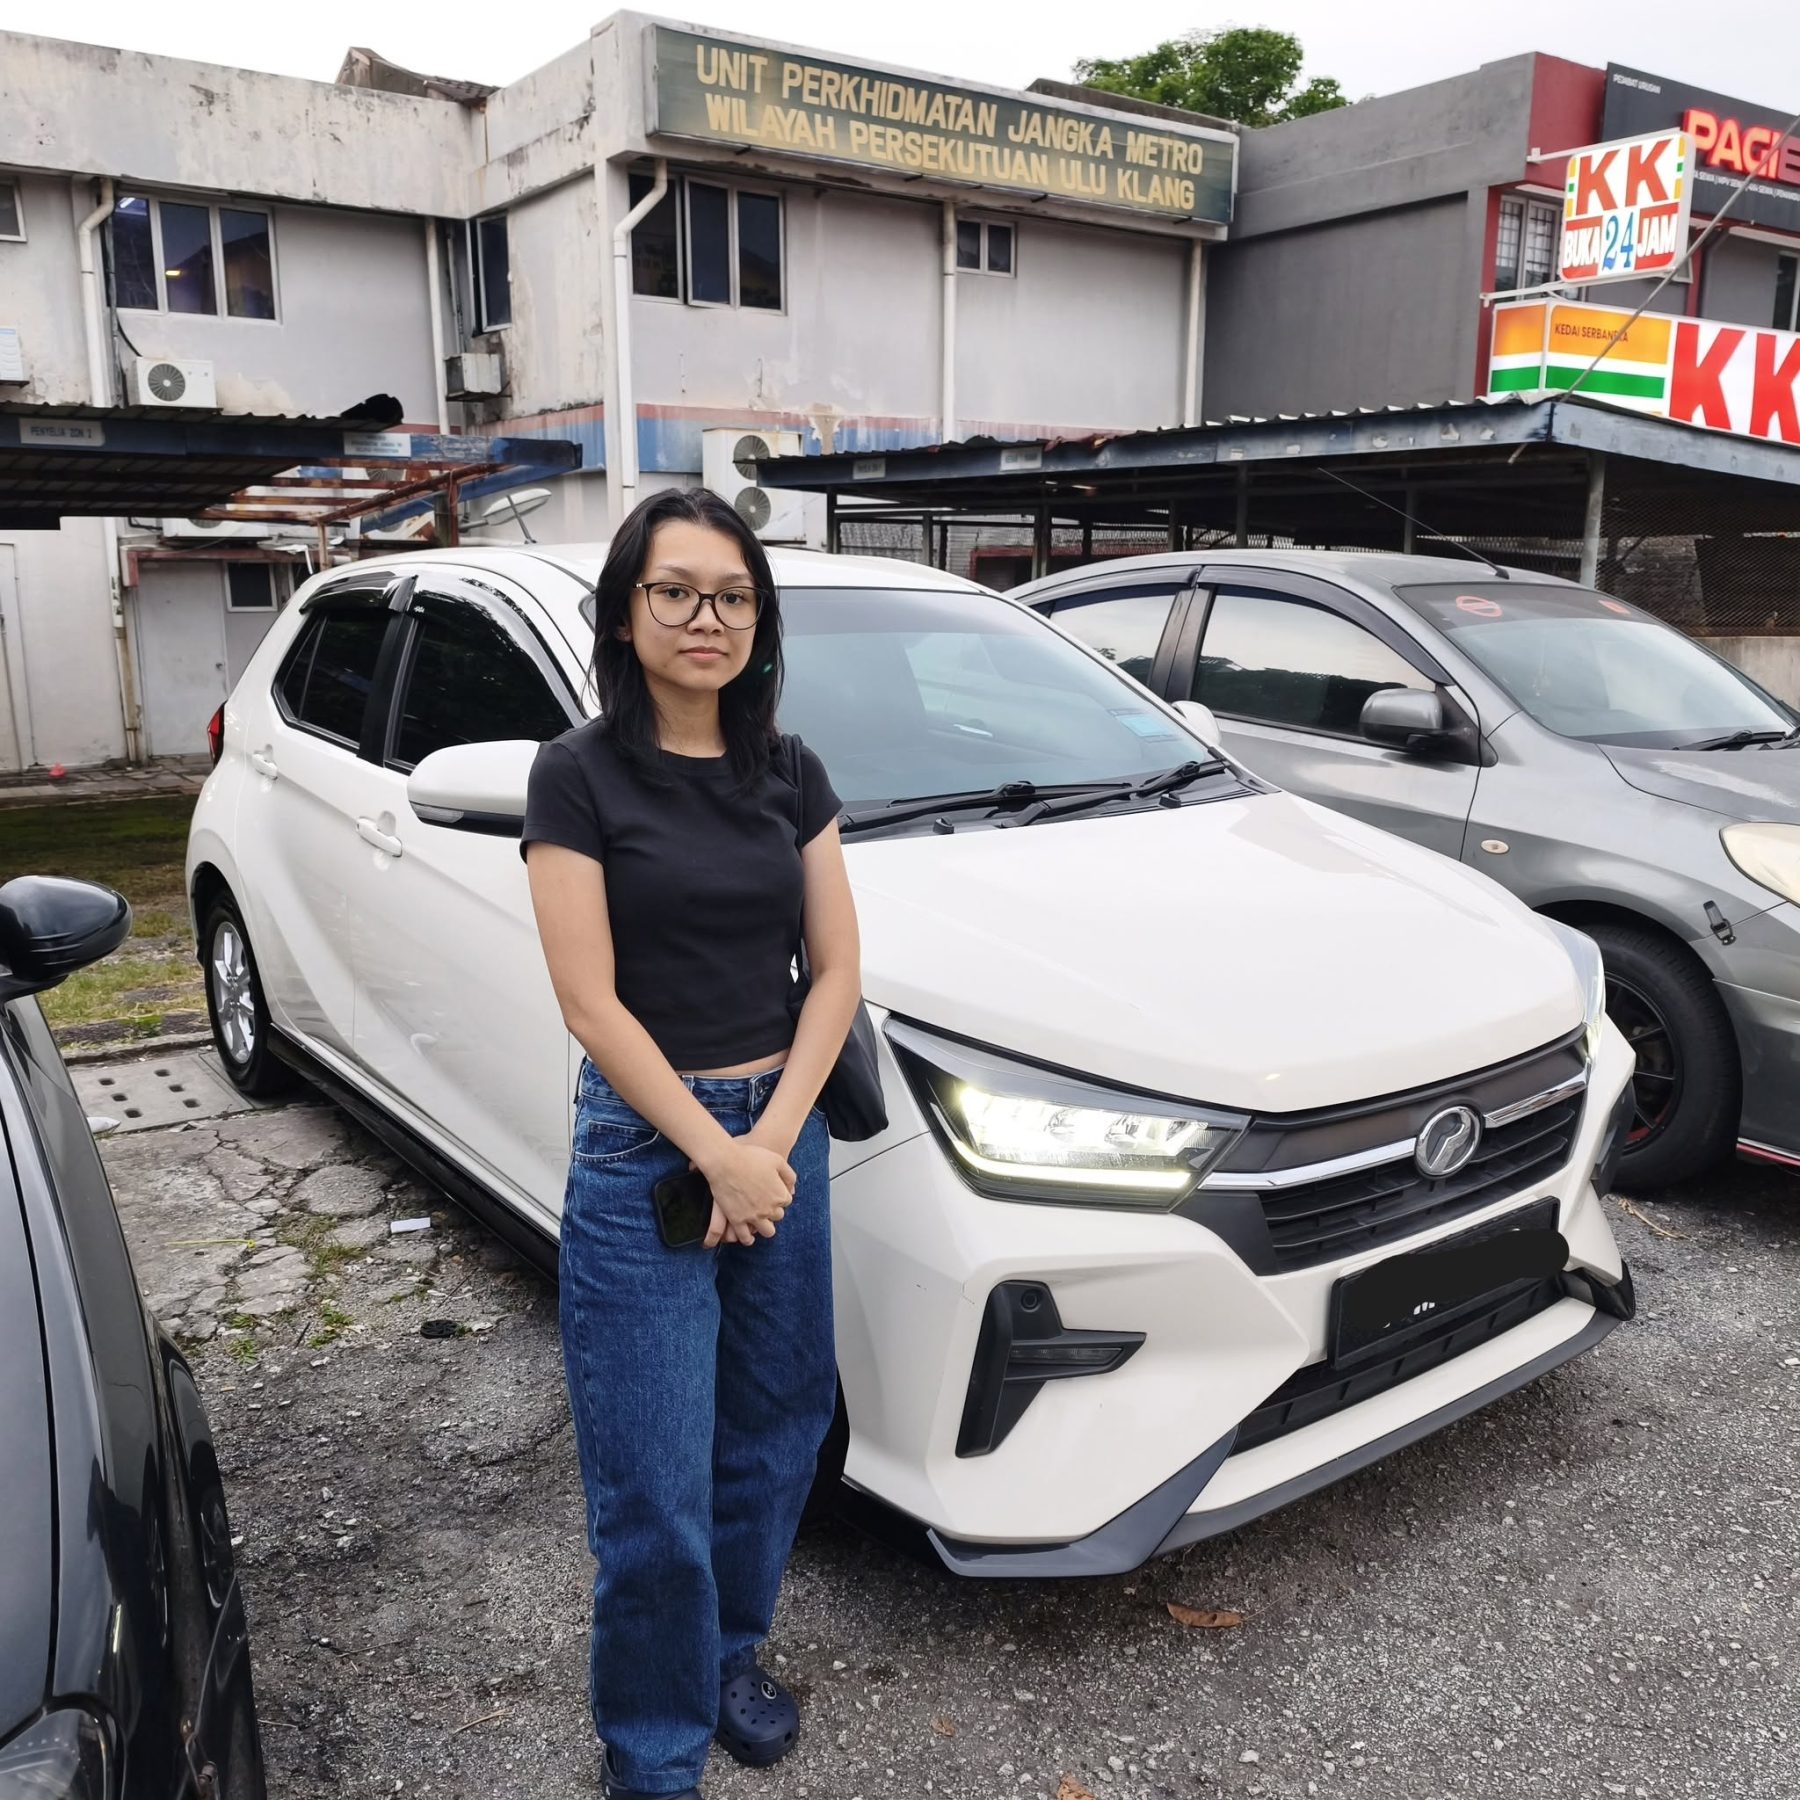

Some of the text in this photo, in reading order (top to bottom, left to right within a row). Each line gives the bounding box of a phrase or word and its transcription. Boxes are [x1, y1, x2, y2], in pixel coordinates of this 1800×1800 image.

[696, 44, 1203, 175] UNIT PERKHIDMATAN JANGKA METRO
[705, 93, 1195, 210] WILAYAH PERSEKUTUAN ULU KLANG
[1576, 139, 1673, 216] KK
[1563, 211, 1677, 271] BUKA 24 JAM
[1555, 323, 1580, 337] KEDAI
